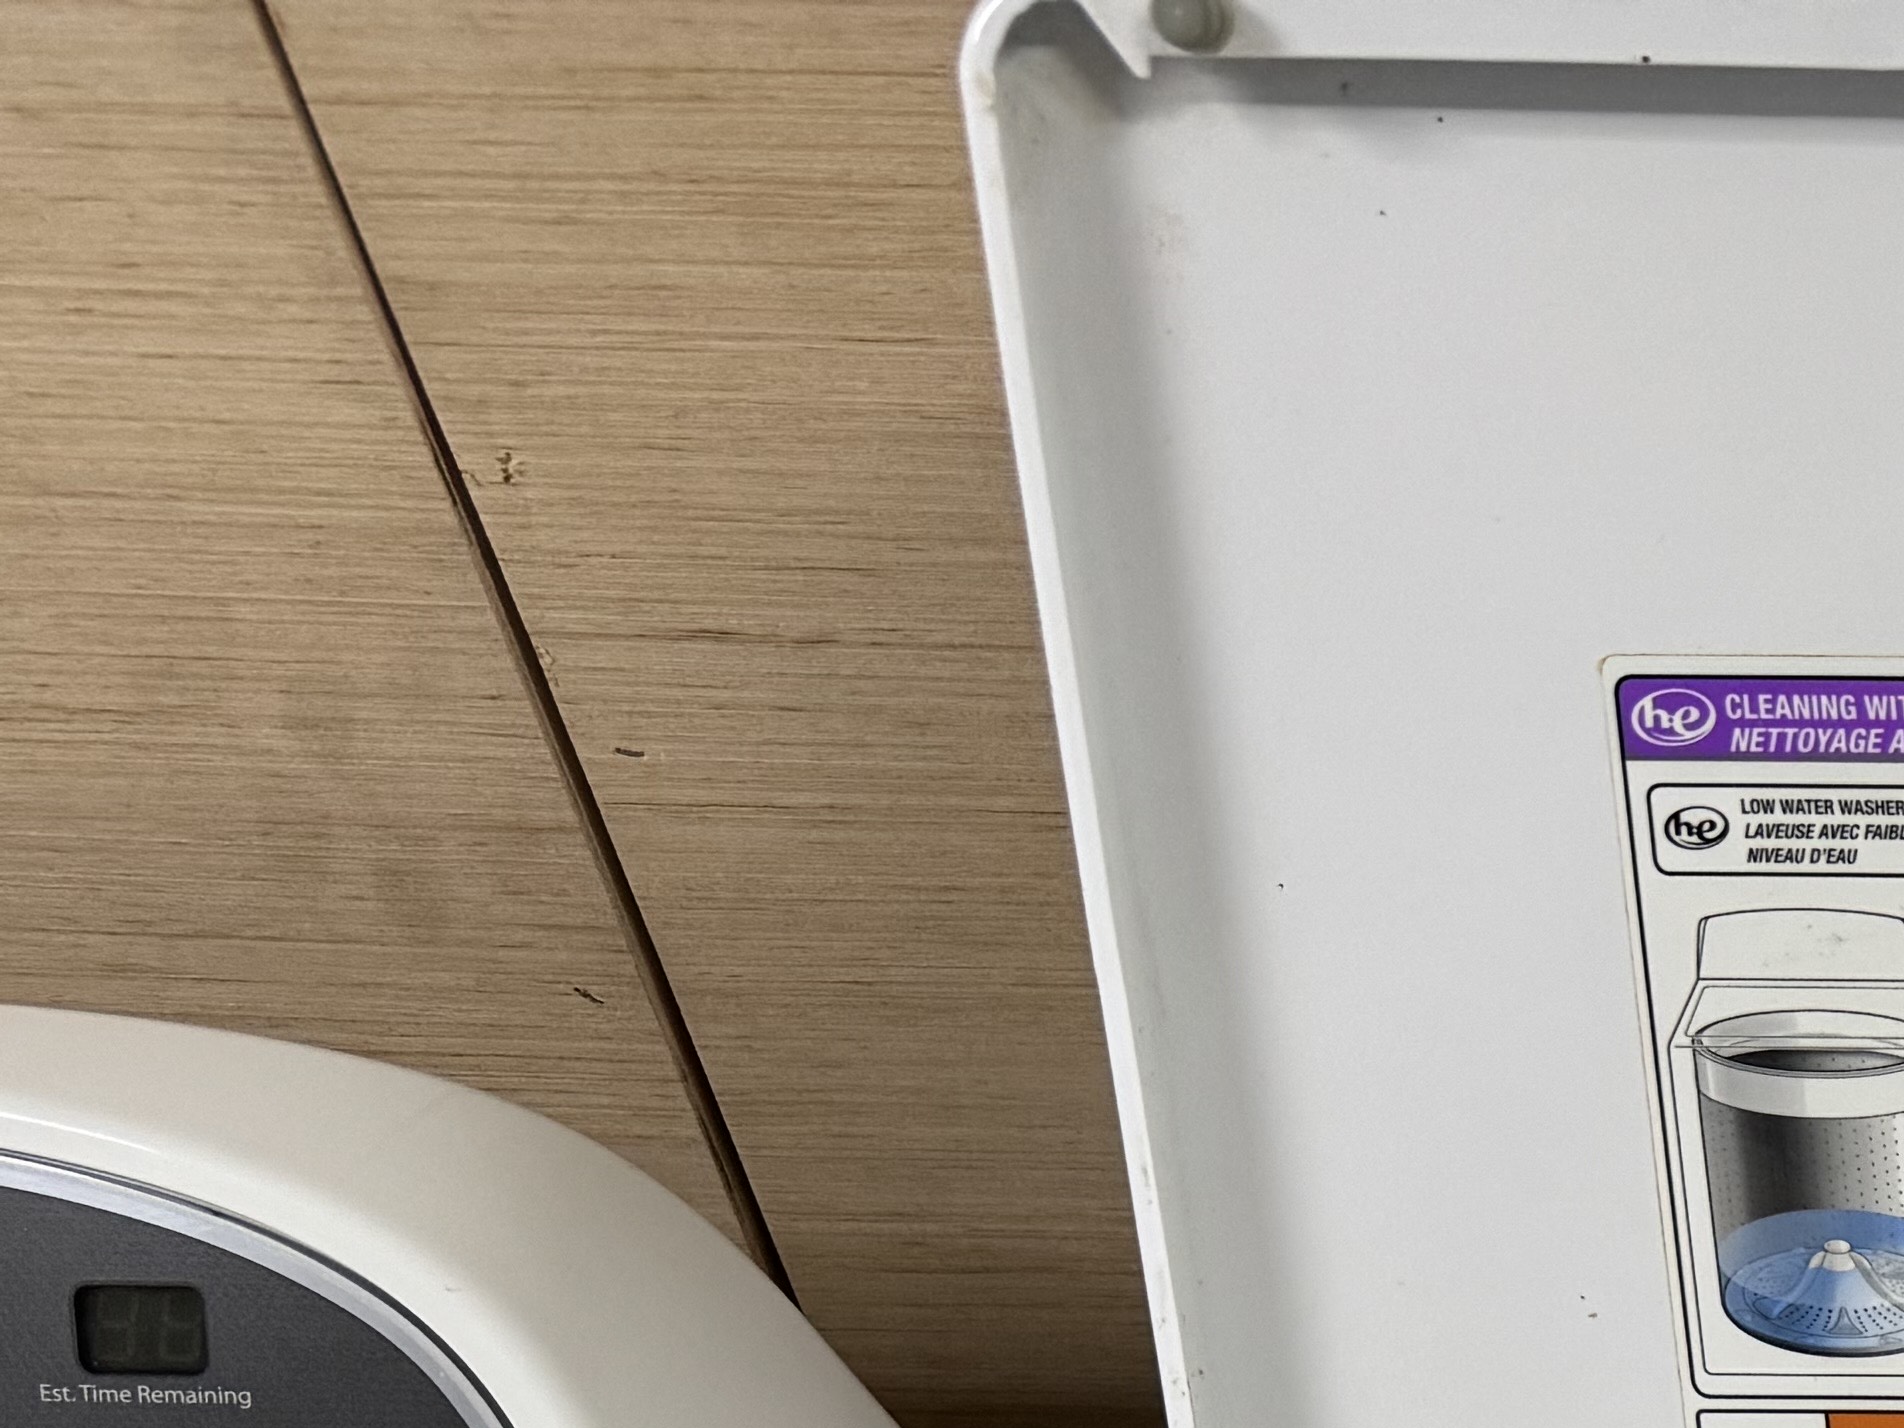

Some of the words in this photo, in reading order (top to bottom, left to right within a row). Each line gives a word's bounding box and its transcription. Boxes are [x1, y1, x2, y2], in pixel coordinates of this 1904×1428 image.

[1725, 694, 1856, 720] CLEANING
[1731, 728, 1884, 753] NETTOYAGE
[1740, 799, 1775, 814] LOW
[1780, 799, 1834, 815] WATER
[1745, 823, 1816, 839] LAVEUSE
[1818, 824, 1860, 840] AVEC
[1747, 848, 1806, 864] NIVEAU
[1810, 848, 1858, 864] D'EAU
[40, 1384, 76, 1402] Est.
[78, 1385, 131, 1402] Time
[138, 1386, 251, 1408] Remaining
